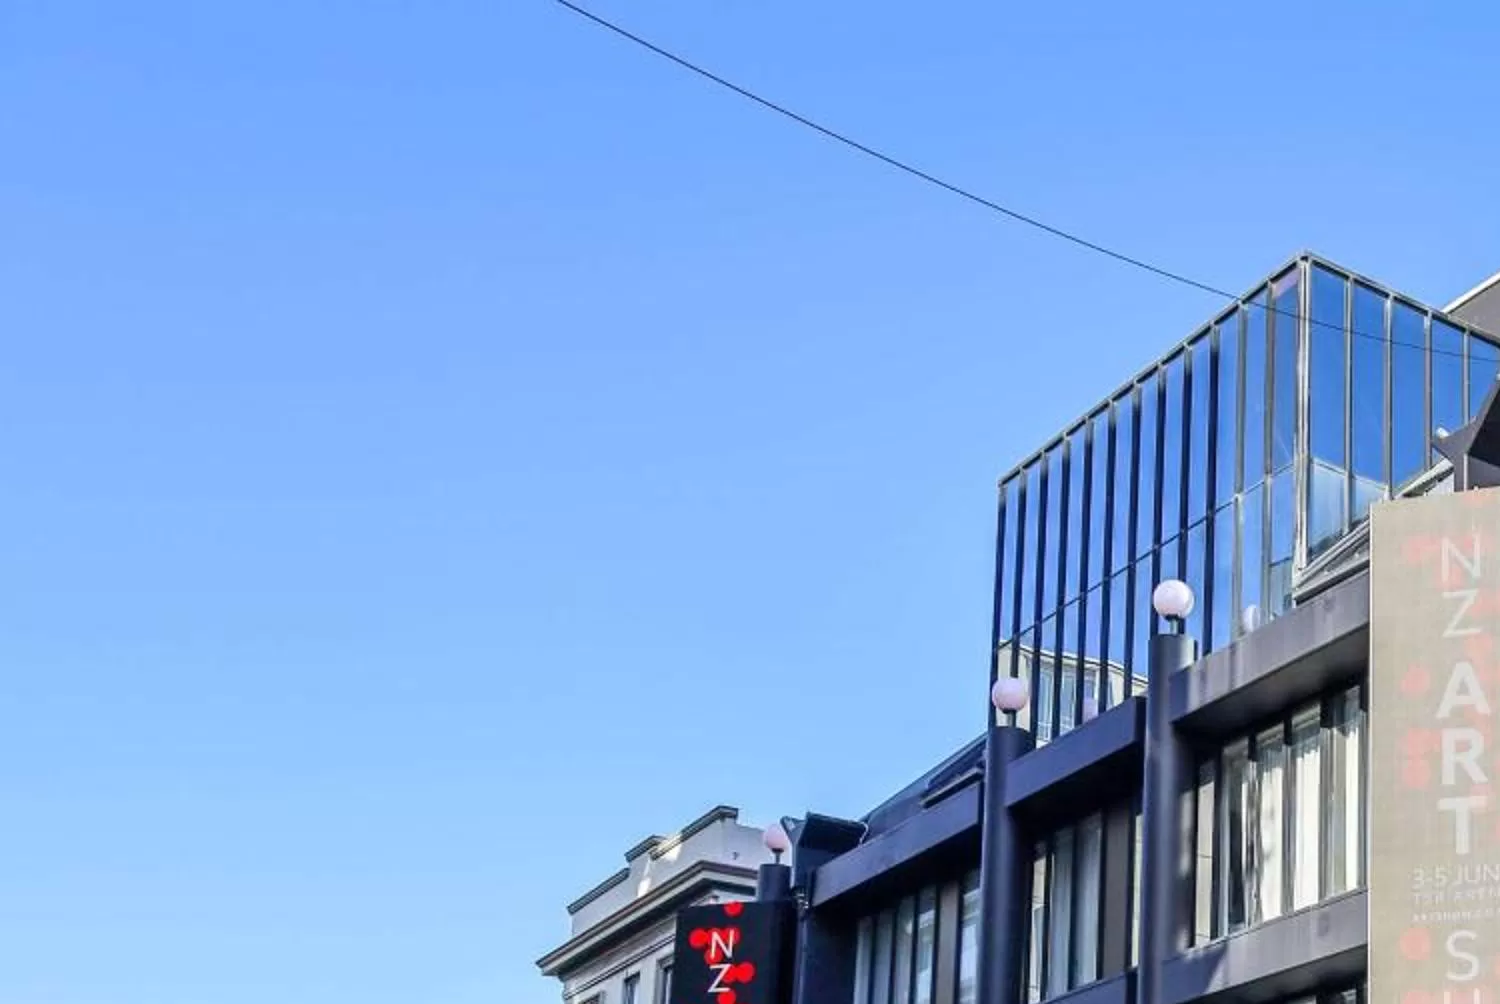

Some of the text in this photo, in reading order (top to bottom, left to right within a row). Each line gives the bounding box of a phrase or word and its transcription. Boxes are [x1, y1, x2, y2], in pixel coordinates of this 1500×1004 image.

[1438, 528, 1484, 639] NZ
[1434, 660, 1493, 856] ART
[706, 928, 736, 993] NZ
